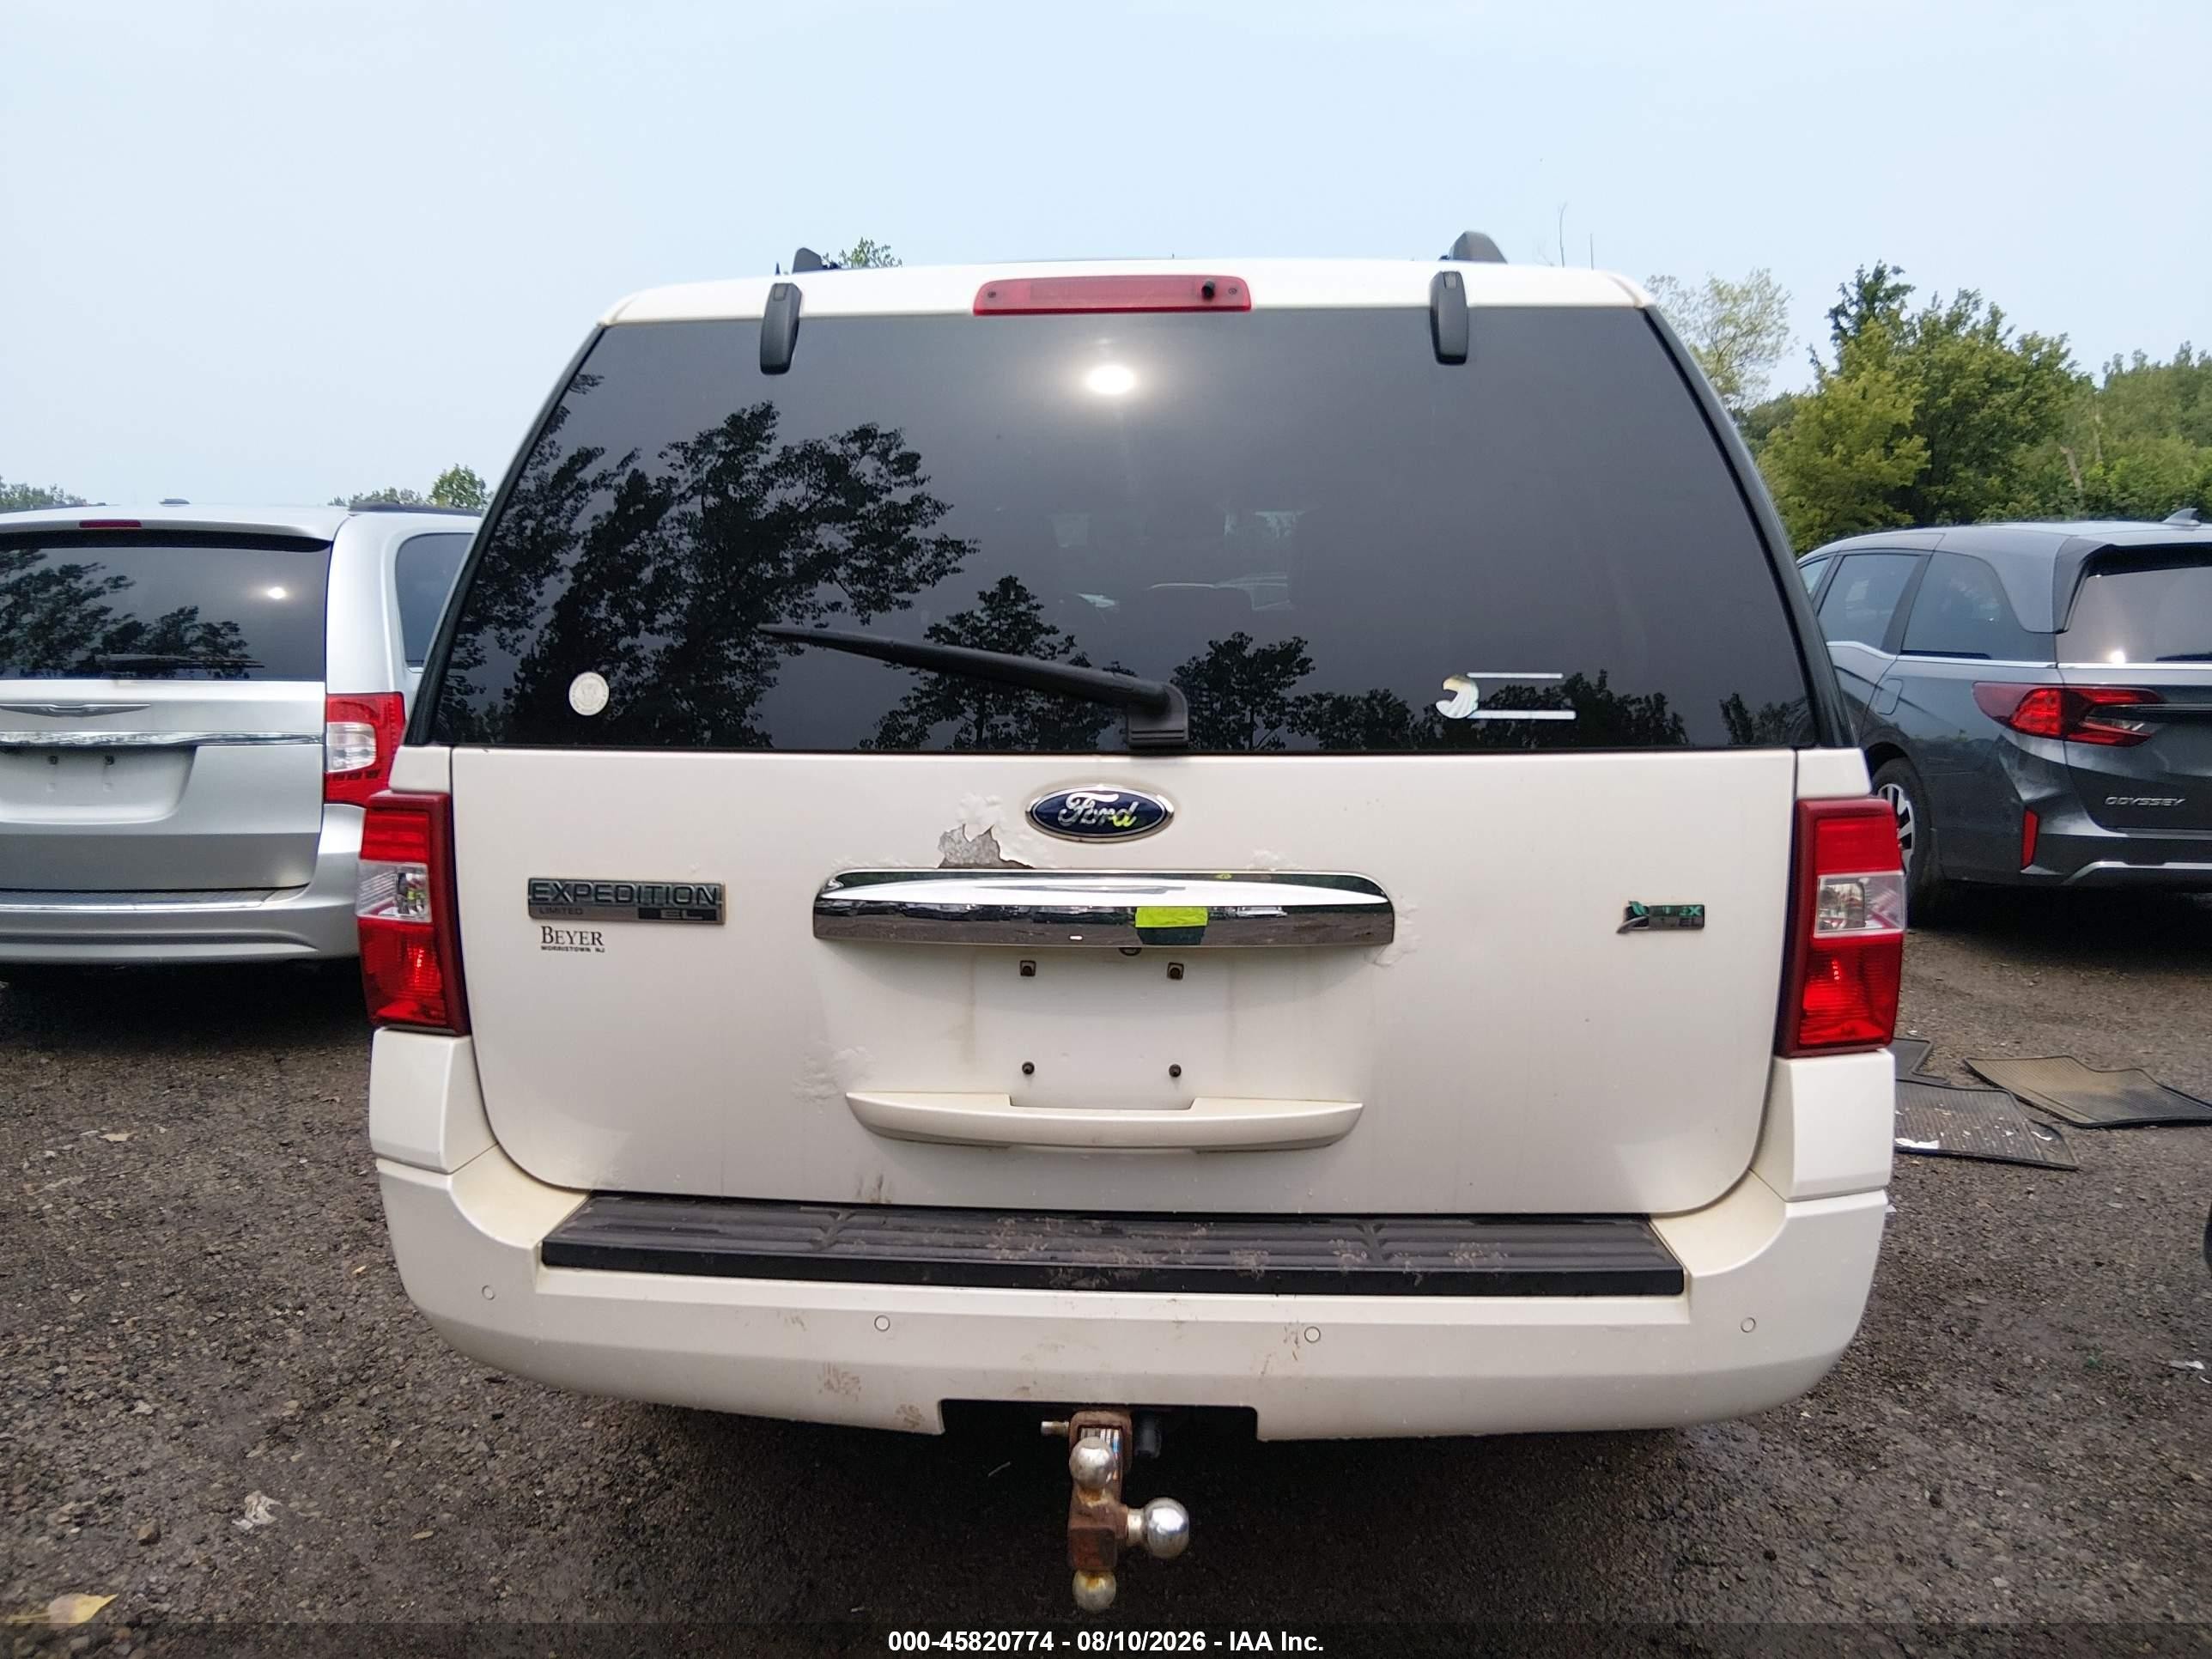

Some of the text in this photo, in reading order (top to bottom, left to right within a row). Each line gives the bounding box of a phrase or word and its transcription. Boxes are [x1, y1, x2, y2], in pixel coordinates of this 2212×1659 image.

[2105, 796, 2186, 806] ODYSSEY
[1057, 791, 1139, 828] Ford
[530, 879, 722, 906] EXPEDITION
[538, 905, 583, 915] LIMITED
[660, 910, 703, 921] EL
